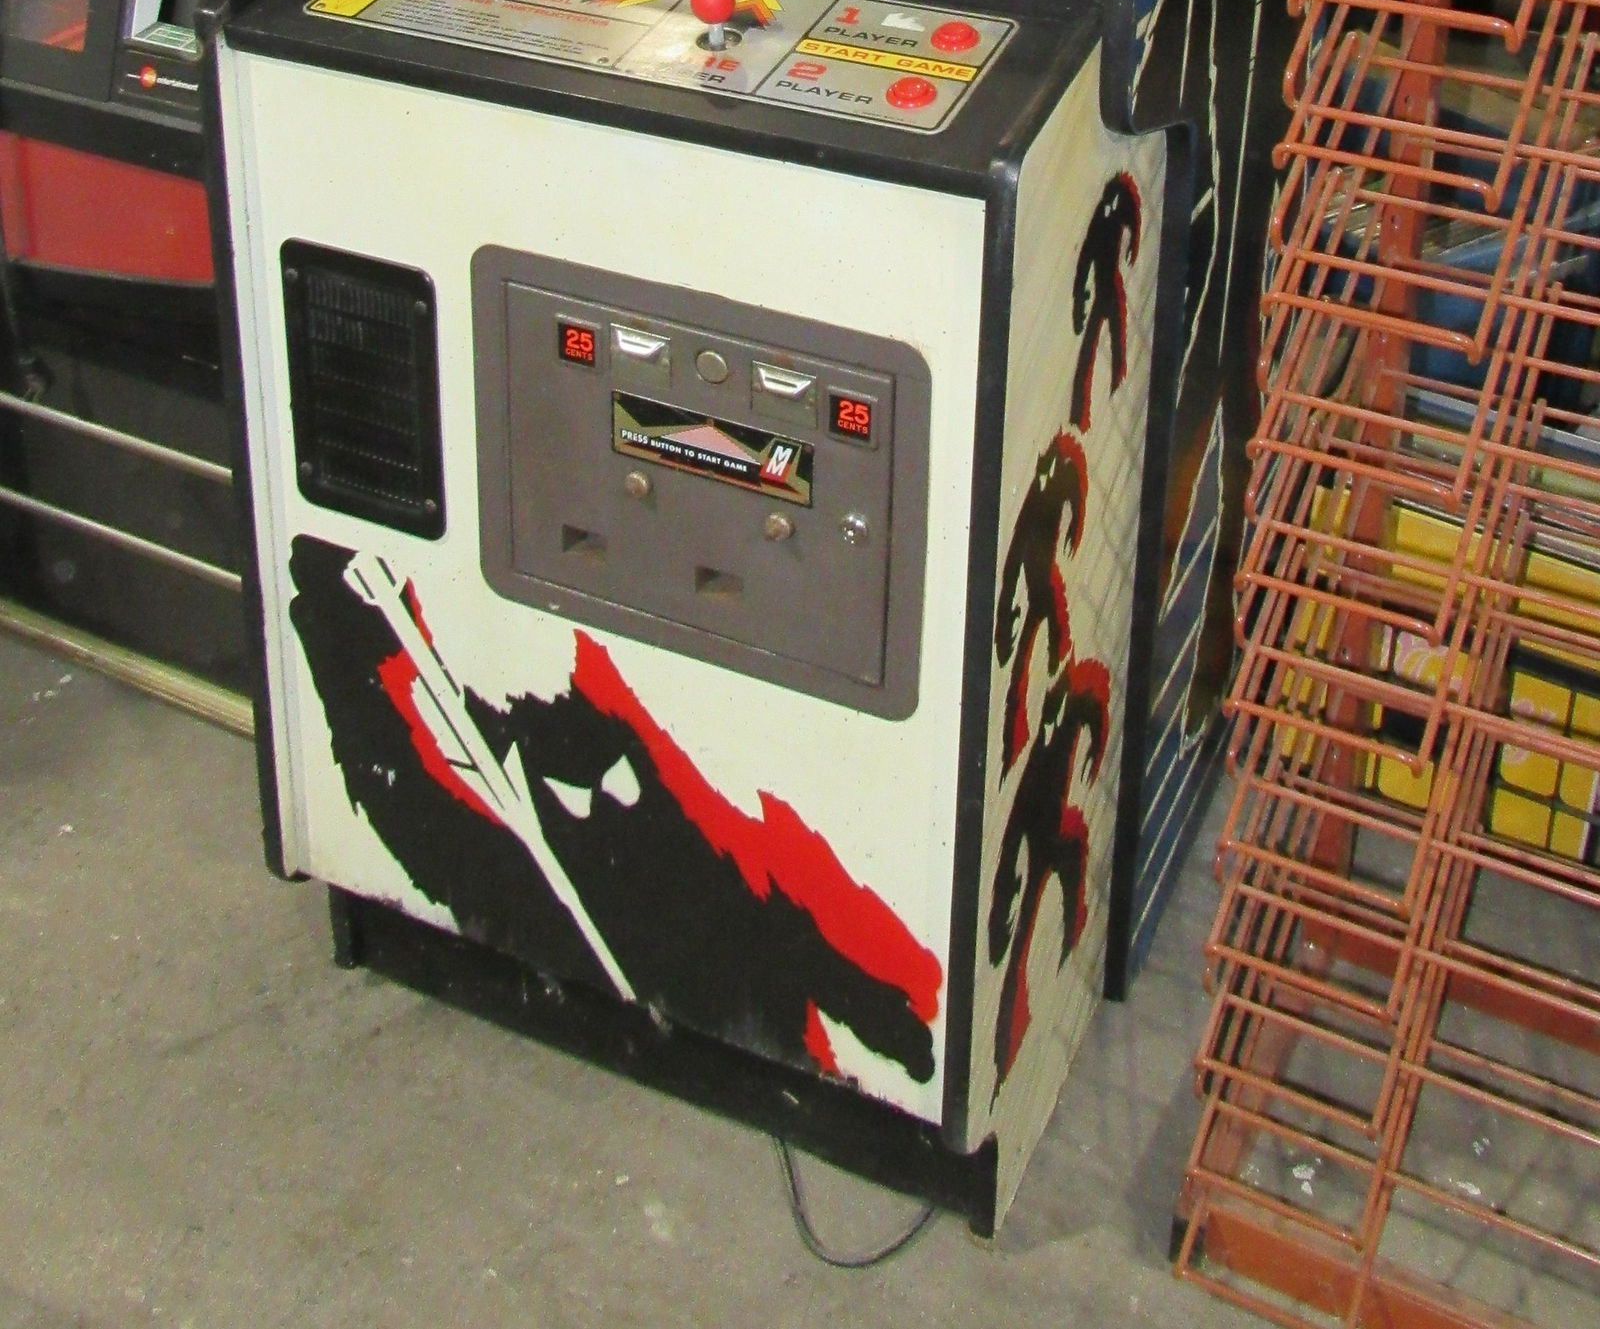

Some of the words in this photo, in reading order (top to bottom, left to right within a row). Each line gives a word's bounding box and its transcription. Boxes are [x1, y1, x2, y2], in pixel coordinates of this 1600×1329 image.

[836, 5, 860, 26] 1
[824, 26, 919, 48] PLAYER
[787, 61, 827, 81] 2
[803, 42, 887, 62] START
[896, 58, 972, 78] GAME
[775, 80, 873, 105] PLAYER
[566, 328, 594, 352] 25
[565, 348, 593, 361] CENTS
[840, 400, 869, 425] 25
[837, 419, 868, 434] CENTS
[621, 429, 649, 445] PRESS
[650, 439, 682, 454] BUTTON
[684, 448, 695, 457] TO
[698, 453, 721, 465] START
[723, 459, 748, 473] GAME
